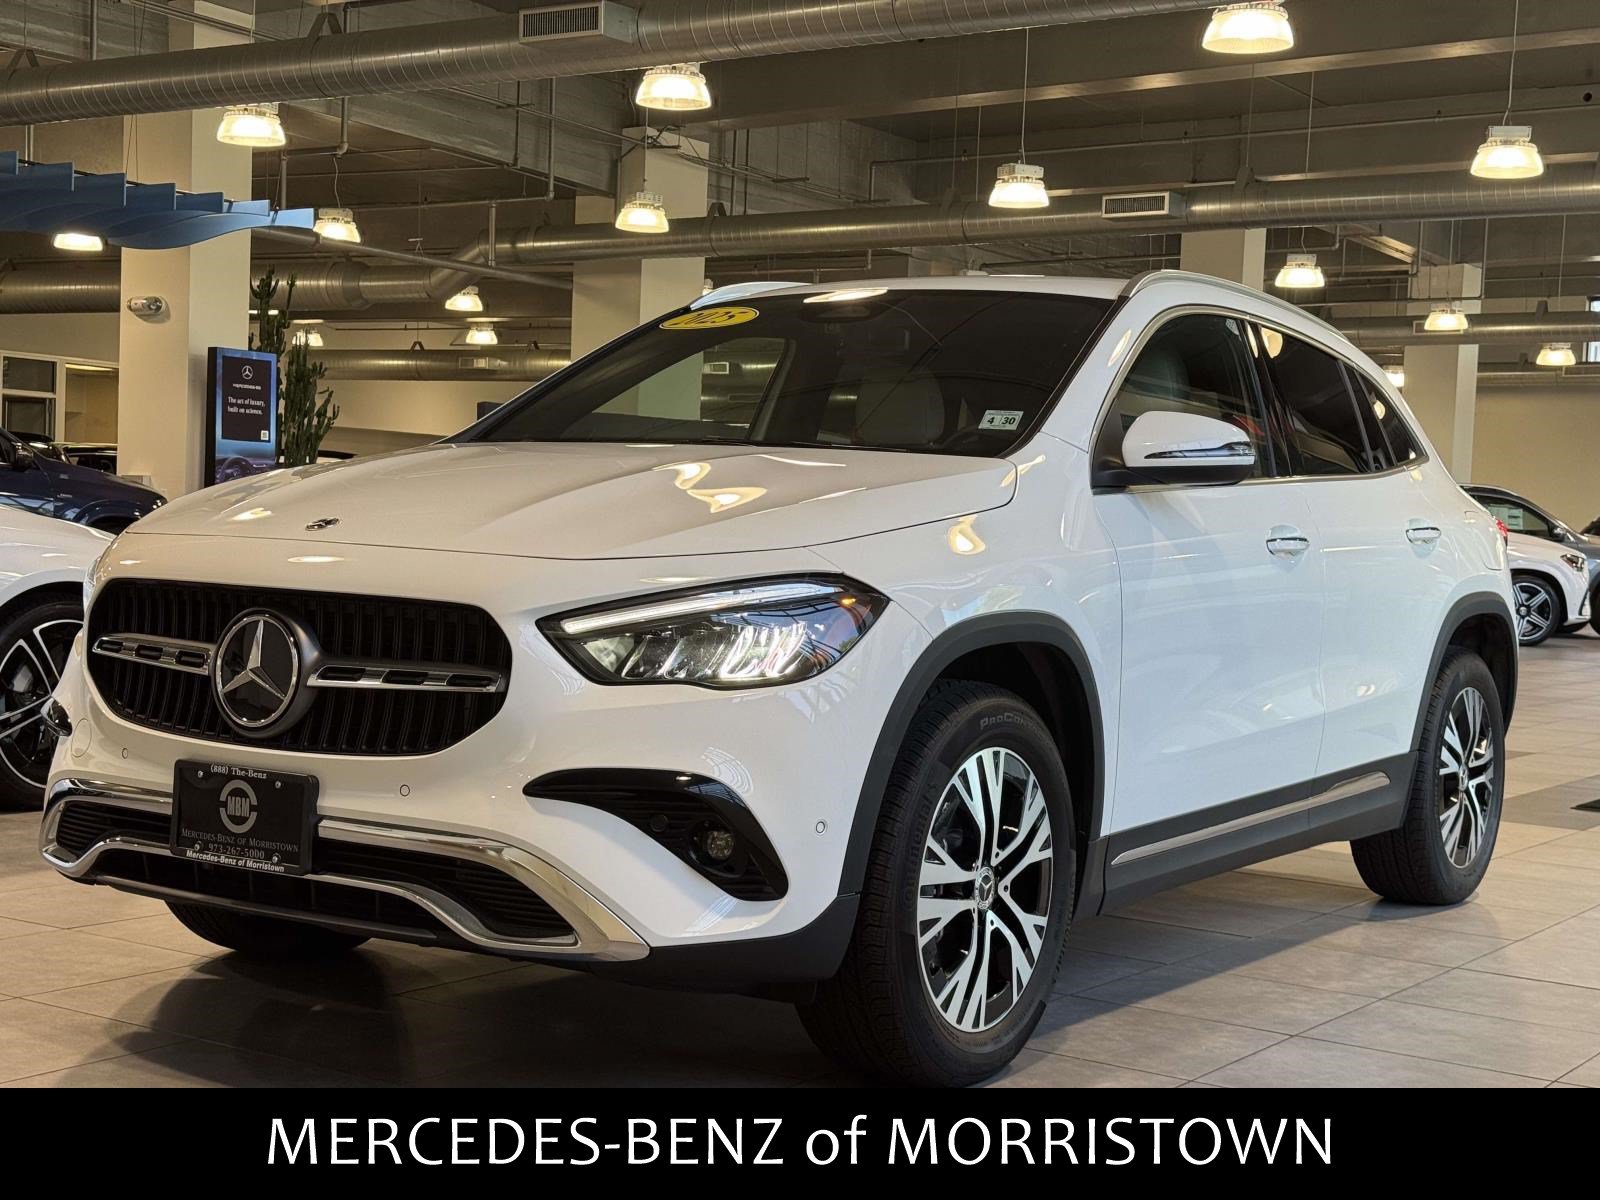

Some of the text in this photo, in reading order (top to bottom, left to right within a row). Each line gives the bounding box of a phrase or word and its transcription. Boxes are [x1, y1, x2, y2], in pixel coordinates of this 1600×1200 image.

[228, 396, 236, 404] The
[987, 416, 1016, 425] 4 30
[210, 764, 267, 779] (888) The-Benz
[227, 795, 250, 817] MBM
[208, 843, 265, 859] 973-267-5000
[186, 849, 285, 873] Mercedes-Benz of Morristown
